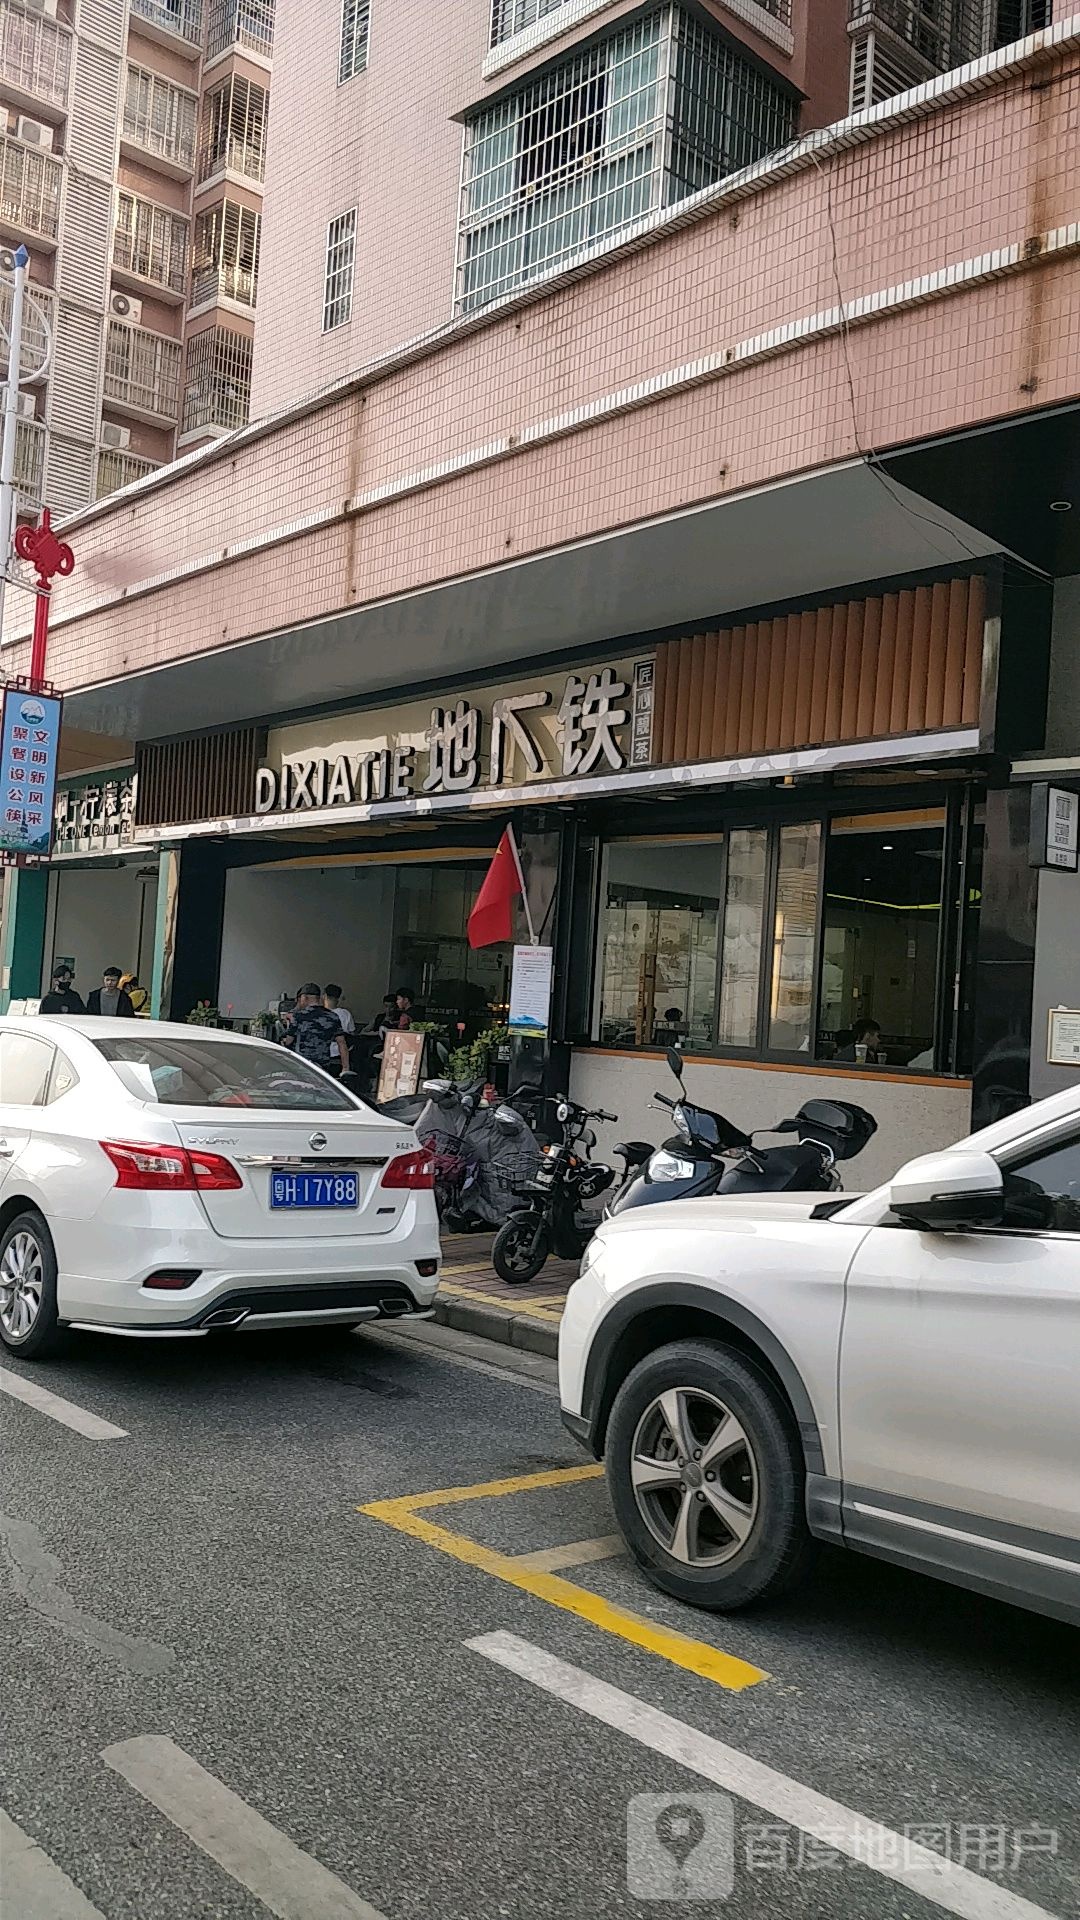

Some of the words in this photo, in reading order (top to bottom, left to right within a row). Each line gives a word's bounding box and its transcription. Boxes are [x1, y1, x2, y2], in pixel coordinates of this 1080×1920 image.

[6, 726, 29, 824] 聚餐设公筷
[28, 729, 49, 825] 文明新风采
[423, 669, 631, 791] 地下铁
[255, 746, 415, 813] DIXIATIE
[71, 825, 86, 839] ONE
